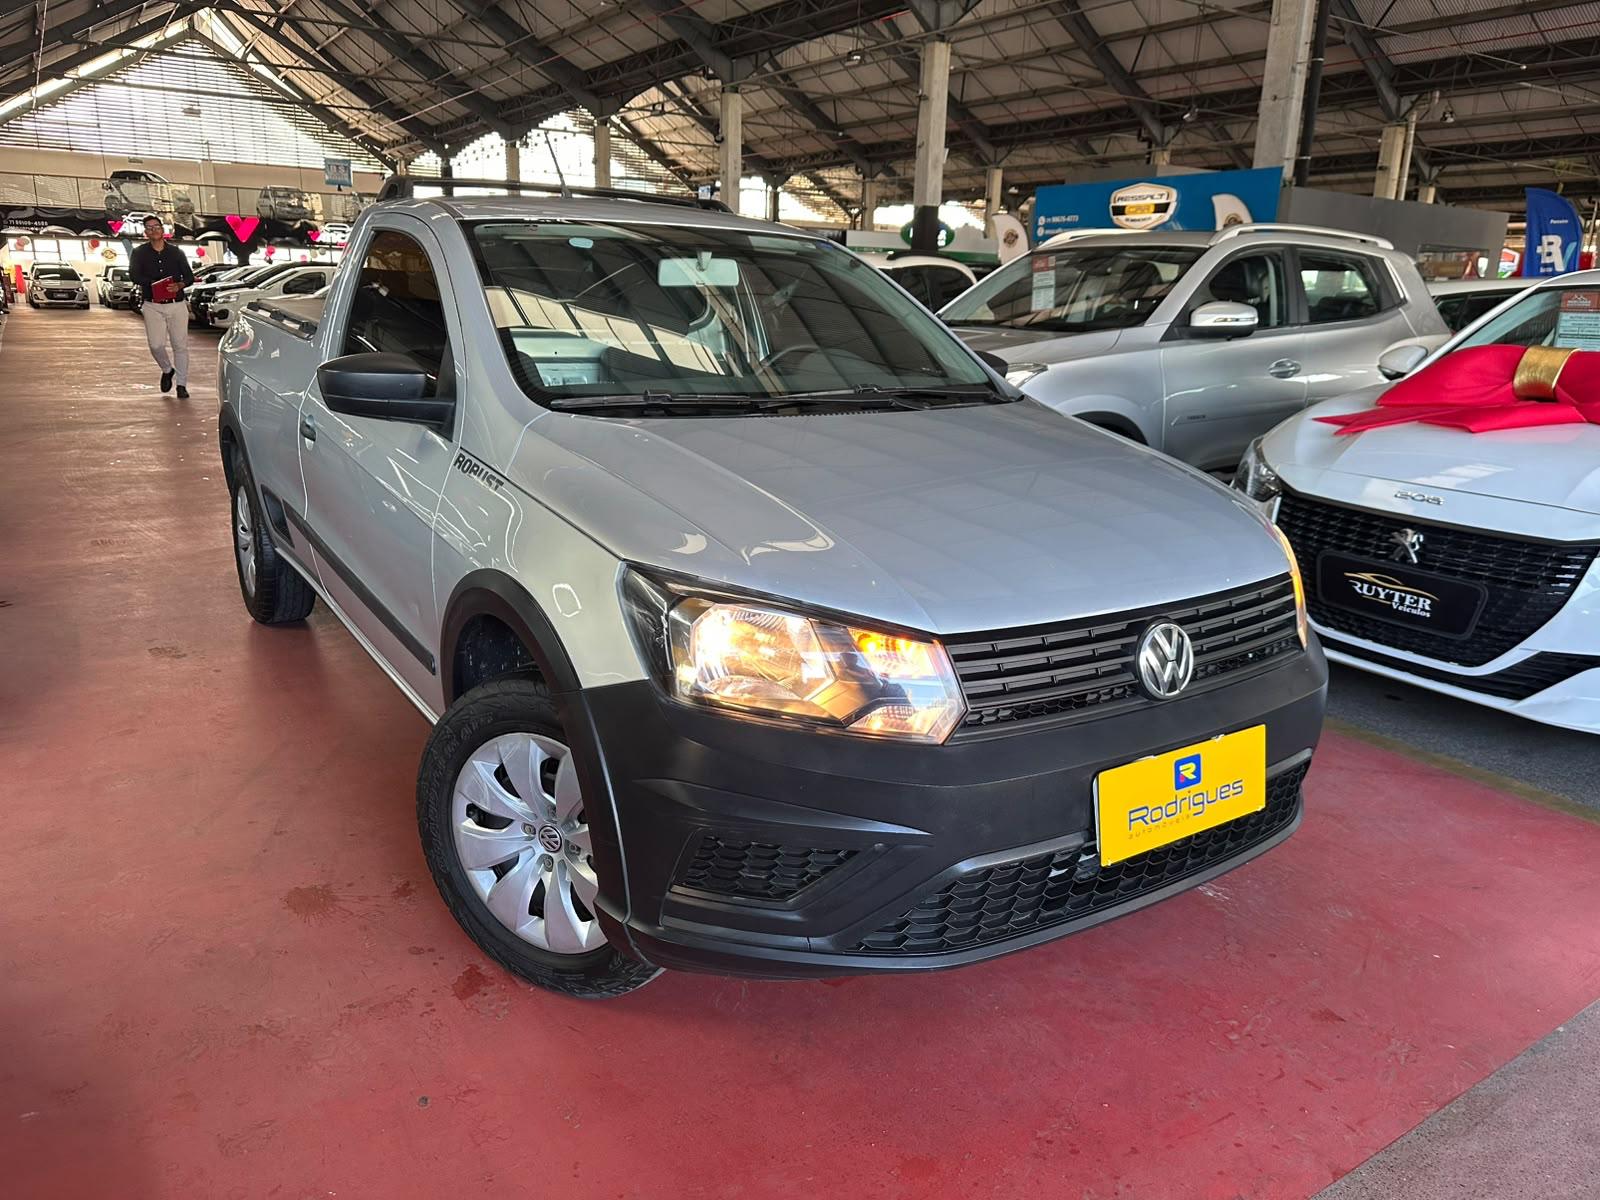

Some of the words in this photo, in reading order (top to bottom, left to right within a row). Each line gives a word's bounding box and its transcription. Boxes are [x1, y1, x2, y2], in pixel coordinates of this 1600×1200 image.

[453, 452, 505, 491] ROBUST
[1349, 579, 1432, 611] RUYTER
[1127, 779, 1243, 832] Rodrigues
